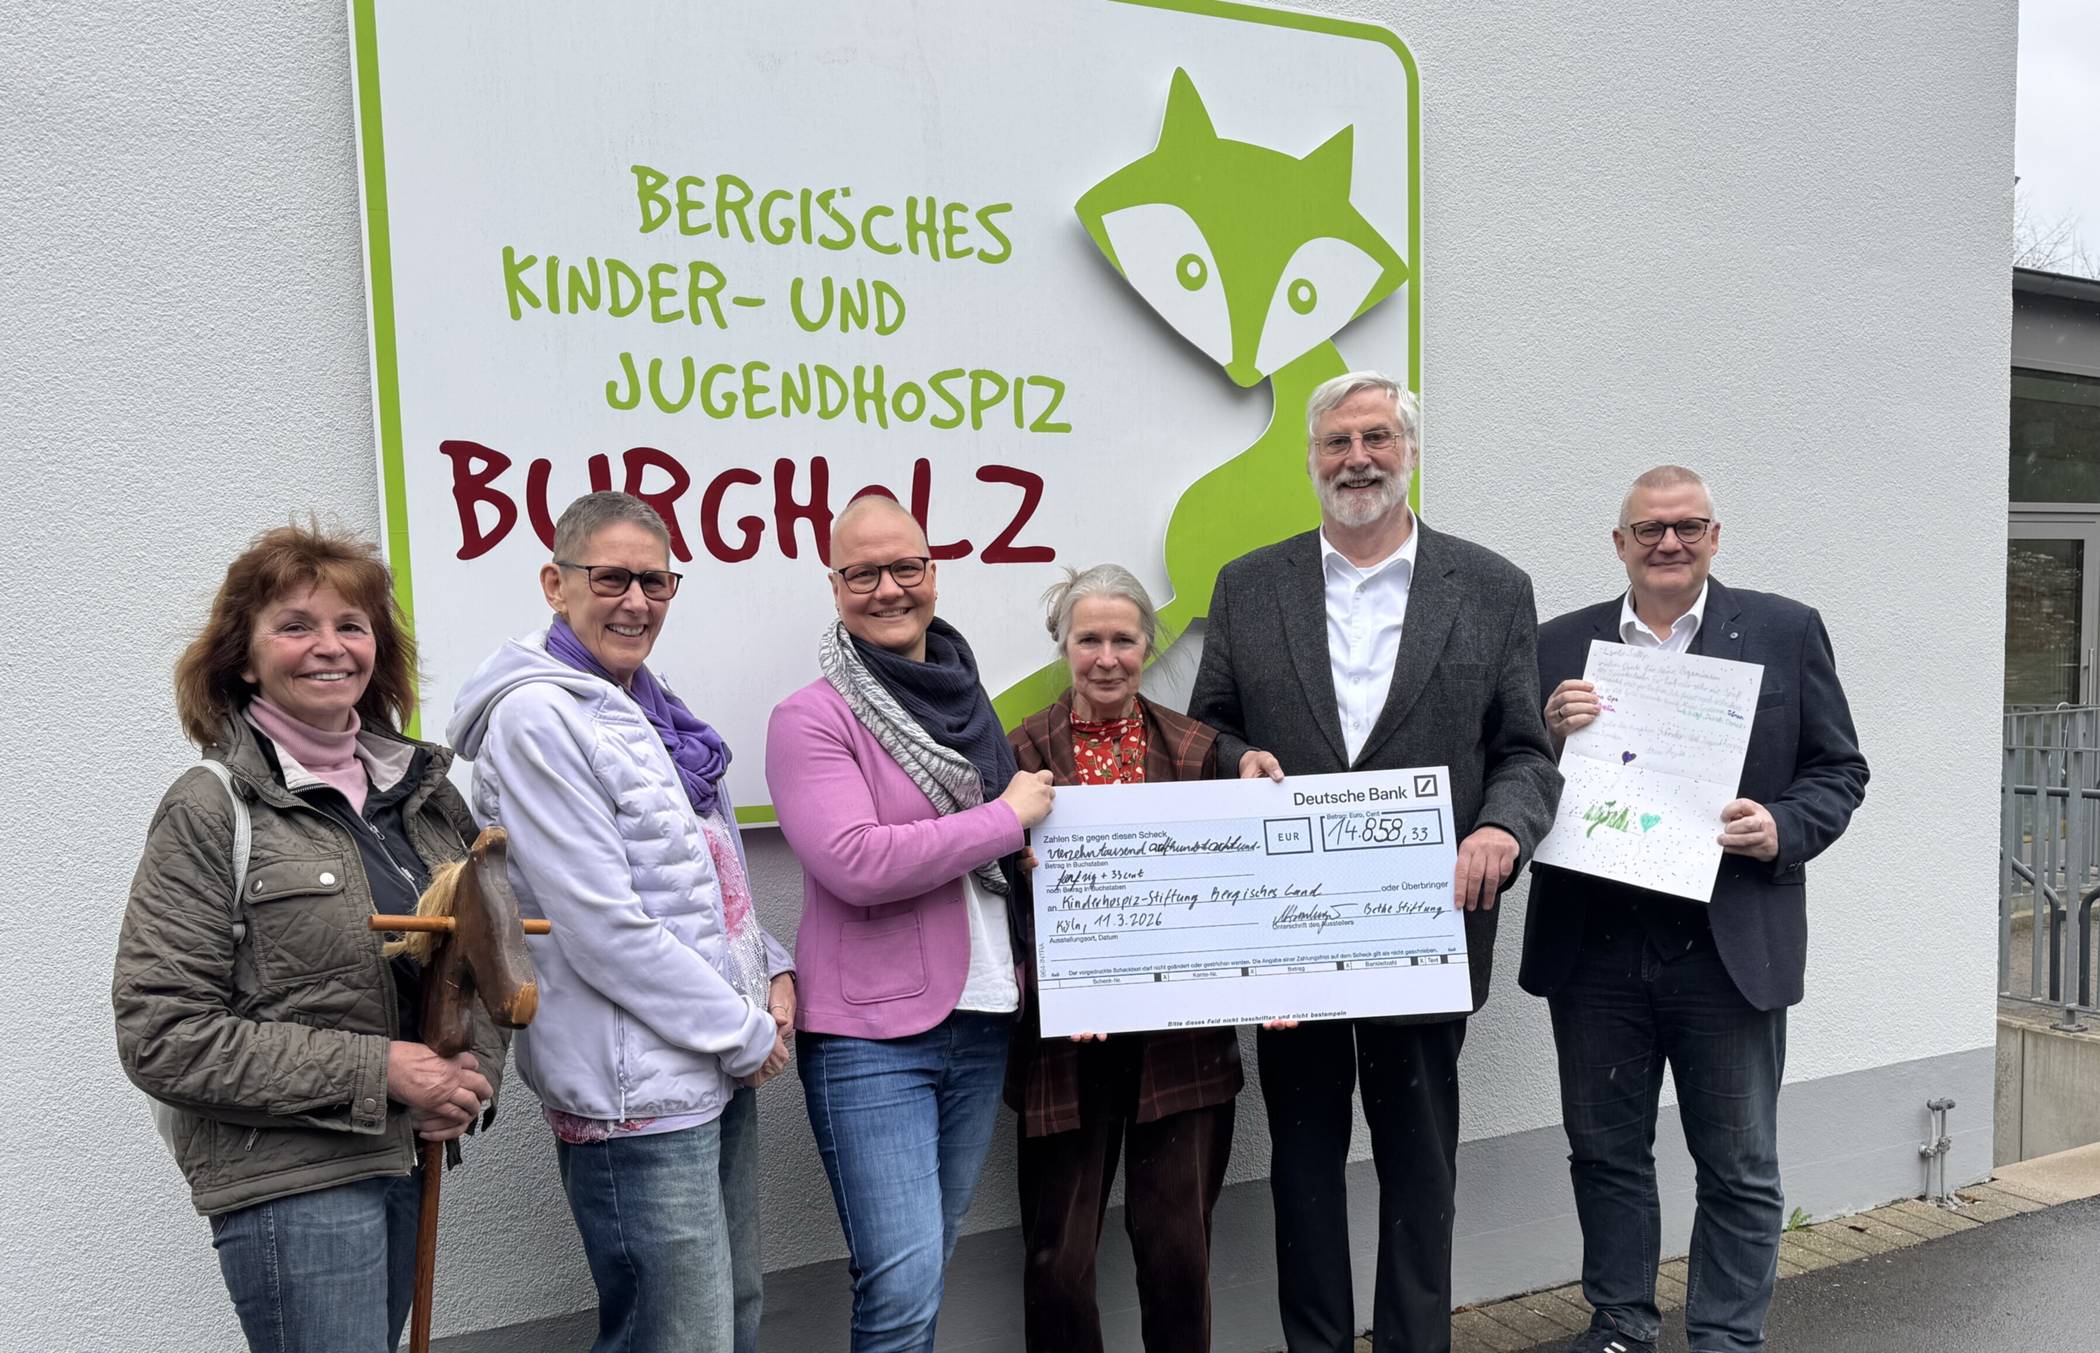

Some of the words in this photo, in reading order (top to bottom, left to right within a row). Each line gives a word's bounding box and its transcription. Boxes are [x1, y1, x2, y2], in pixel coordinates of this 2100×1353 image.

[632, 165, 1013, 264] BERGISCHES
[502, 246, 766, 329] KINDER-
[790, 276, 906, 336] UND
[606, 352, 1072, 433] JUGENDHOSPIZ
[440, 440, 1056, 567] BURGHLZ
[1293, 788, 1366, 806] Deutsche
[1368, 786, 1408, 801] Bank
[1043, 835, 1070, 844] Zahlen
[1071, 834, 1084, 842] Sie
[1086, 834, 1110, 843] gegen
[1111, 831, 1137, 840] diesen
[1139, 830, 1168, 839] Scheck
[1278, 832, 1300, 842] EUR
[1045, 862, 1065, 870] Betrag
[1401, 880, 1448, 891] Überbringer
[1396, 900, 1446, 920] Stiftung
